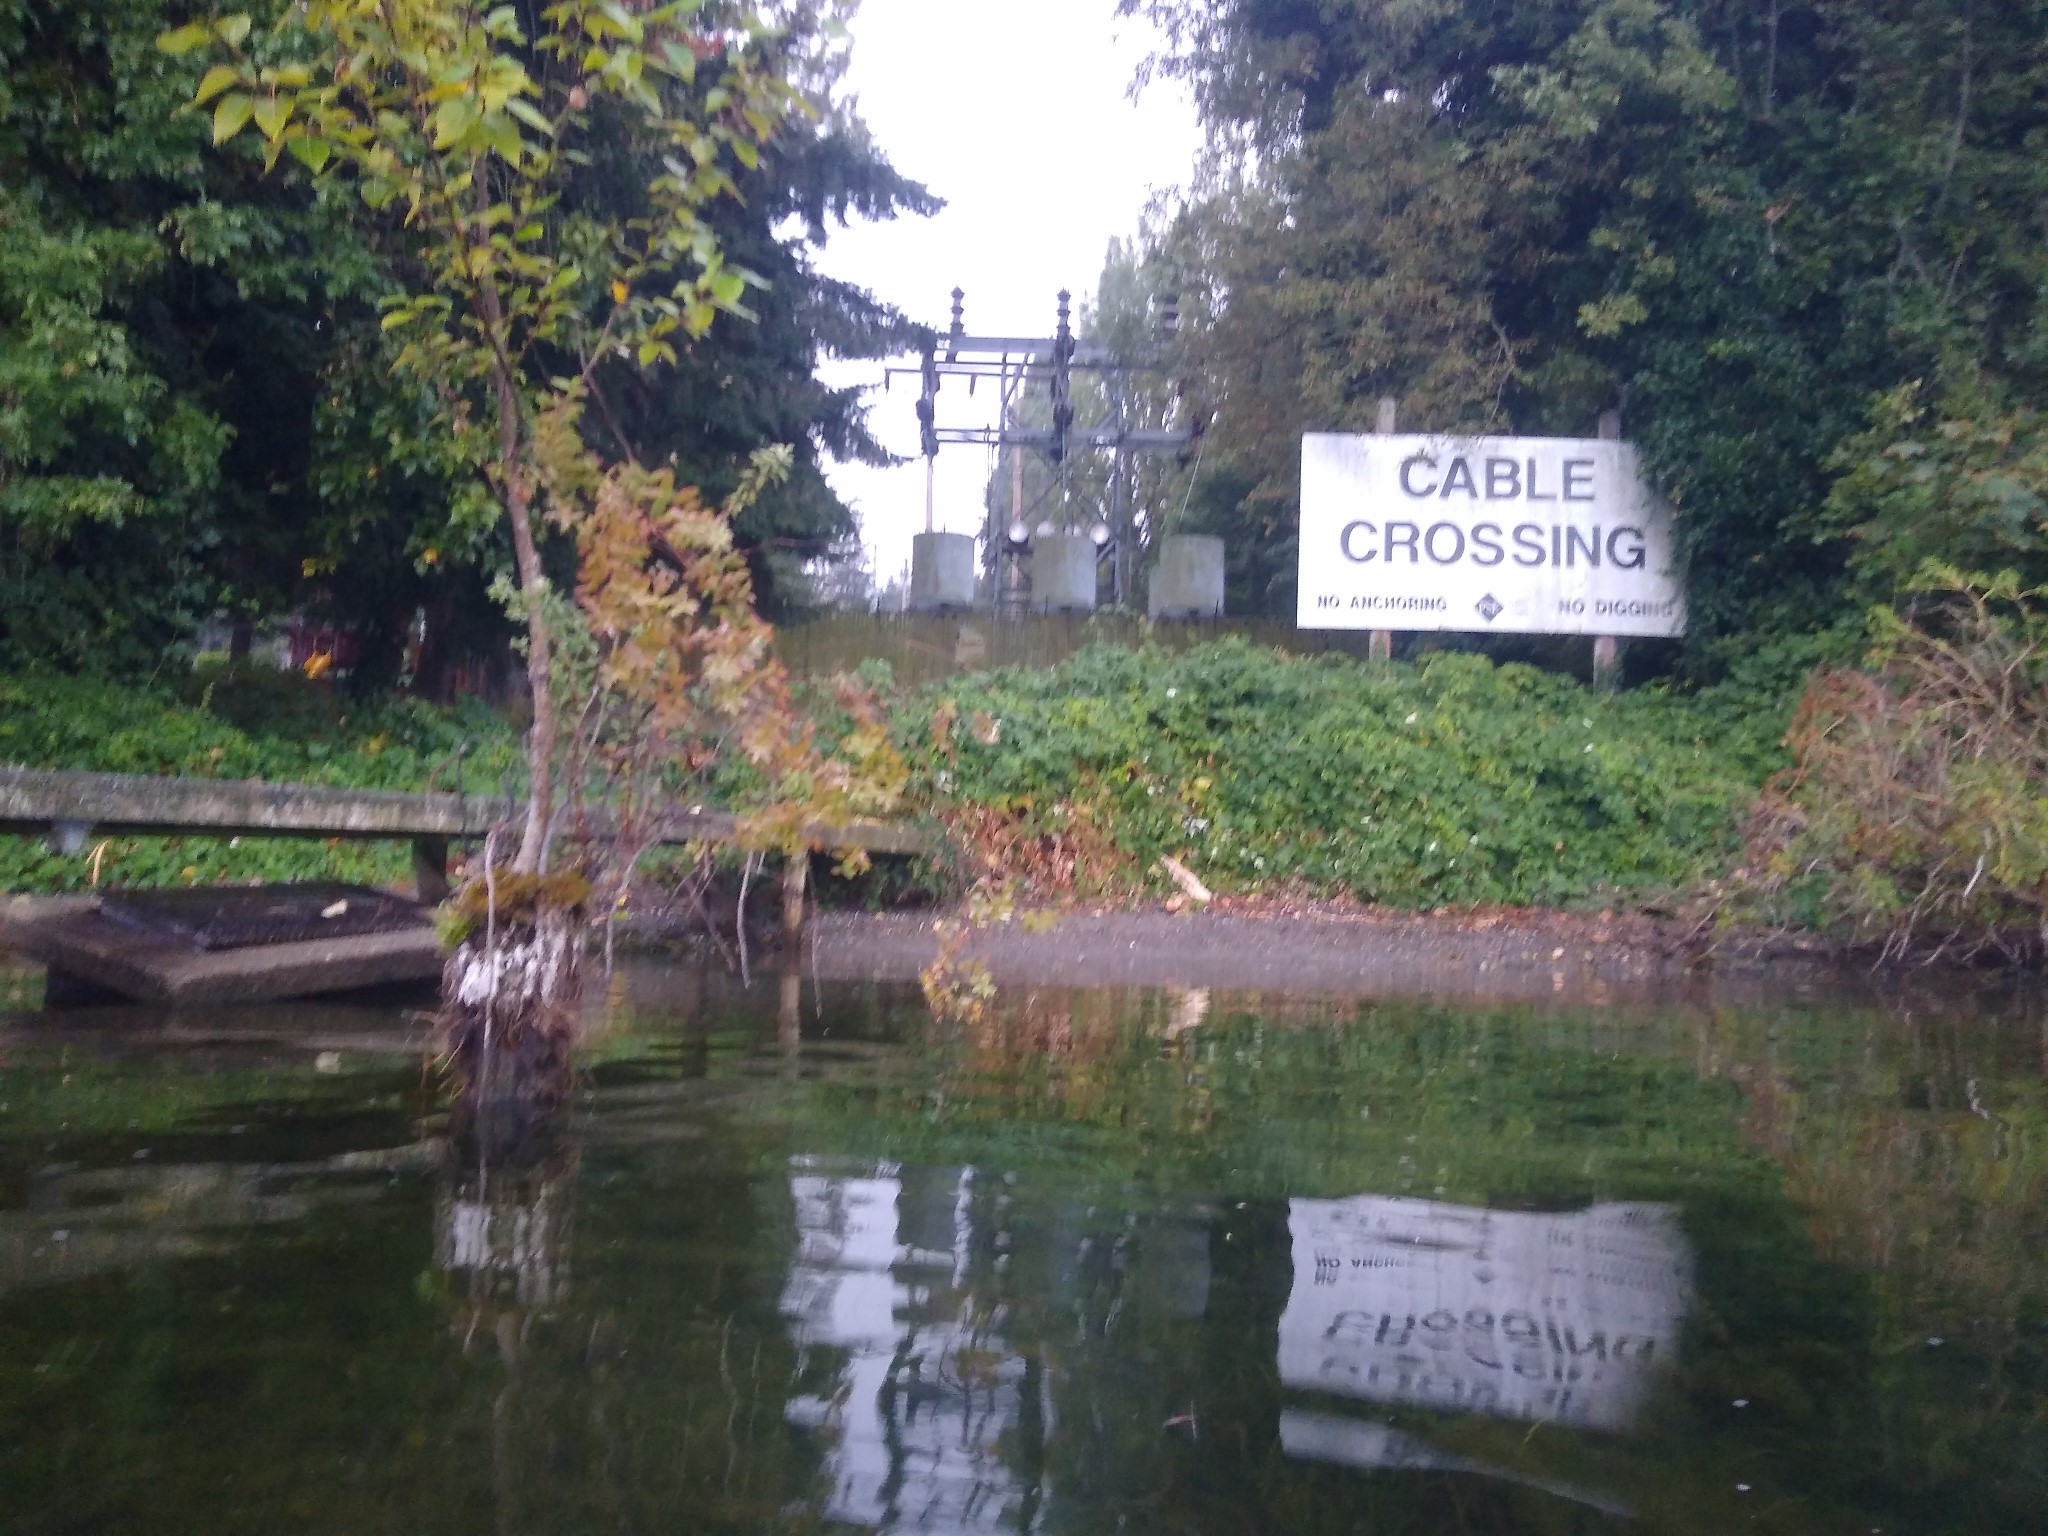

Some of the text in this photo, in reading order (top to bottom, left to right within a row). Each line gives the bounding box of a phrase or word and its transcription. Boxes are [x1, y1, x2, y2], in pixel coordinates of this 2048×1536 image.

[1400, 455, 1595, 501] CABLE
[1340, 520, 1647, 569] CROSSING
[1317, 595, 1448, 611] NO ANCHORING
[1559, 599, 1674, 617] NO DIGGING
